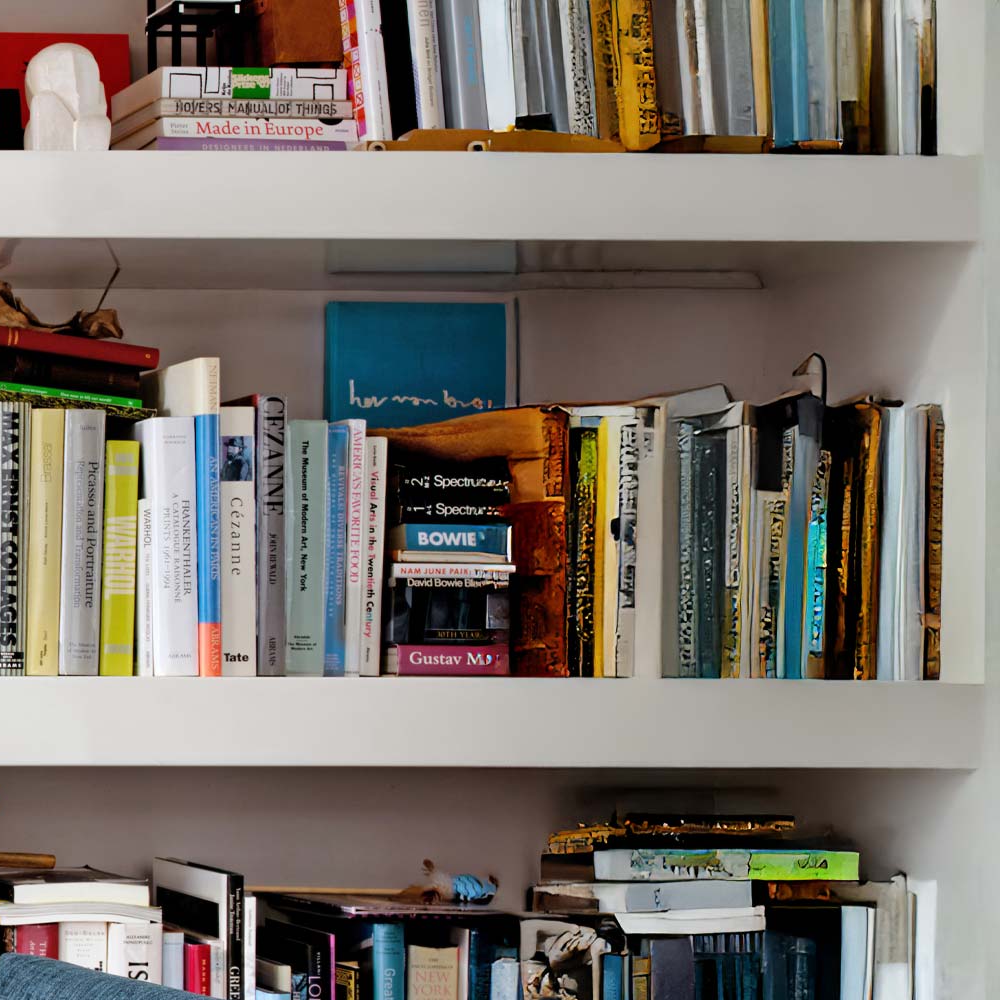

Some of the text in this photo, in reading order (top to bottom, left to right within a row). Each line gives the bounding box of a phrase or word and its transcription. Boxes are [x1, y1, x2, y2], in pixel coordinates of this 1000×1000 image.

[196, 121, 323, 140] Made in Europe
[262, 396, 285, 516] CEZANNE
[301, 457, 309, 490] Museum
[301, 493, 309, 501] of
[0, 411, 19, 647] MAX ERNST COLLAGES
[84, 461, 99, 608] Picasso and Portraiture
[143, 509, 151, 548] WARHOL
[301, 504, 309, 534] Modern
[182, 500, 191, 595] FRANKENTHALER
[230, 497, 245, 576] Cézanne
[300, 536, 308, 551] Art,
[418, 531, 477, 546] BOWIE
[104, 515, 137, 600] WARHOL
[300, 554, 308, 571] New
[349, 550, 360, 583] FOOD
[364, 471, 379, 638] Visual Arts in the Twentieth Century
[407, 578, 433, 587] David
[434, 579, 463, 588] Bowie
[211, 628, 219, 670] ABRAMS
[224, 653, 249, 662] Tate
[409, 652, 461, 665] Gustav
[383, 968, 395, 1000] Great
[413, 984, 450, 996] YORK
[416, 970, 448, 982] NEW
